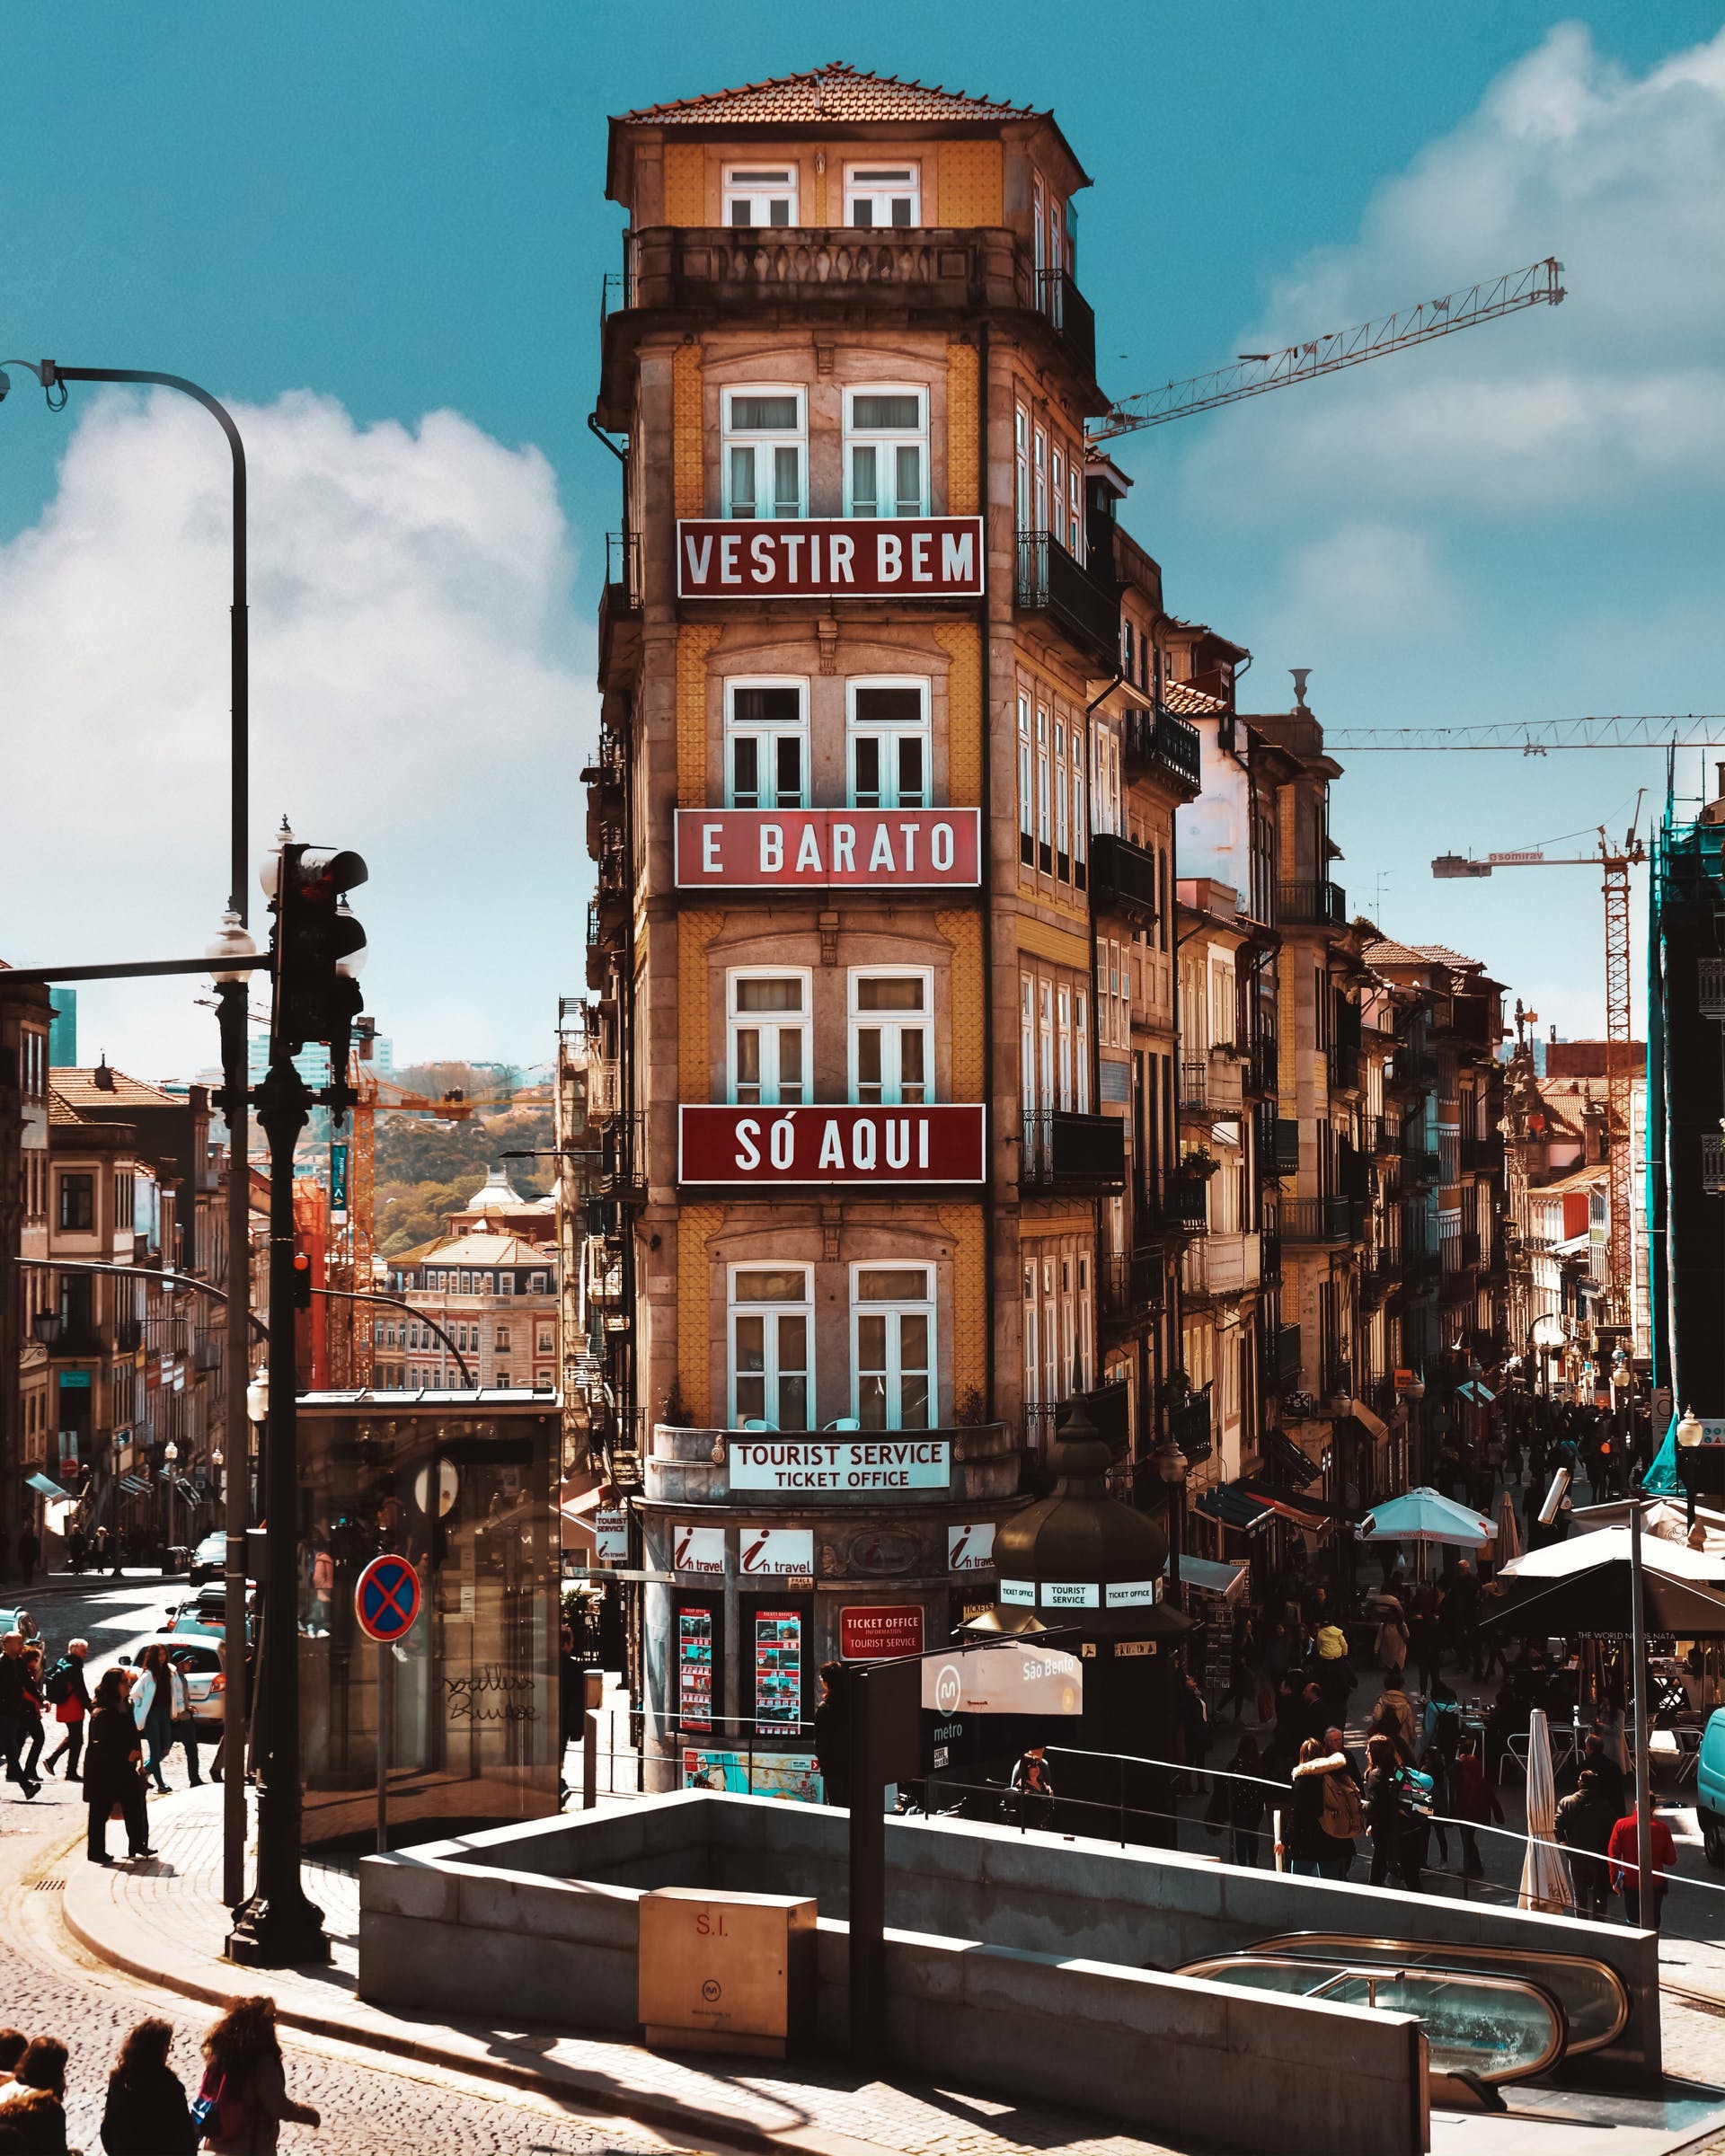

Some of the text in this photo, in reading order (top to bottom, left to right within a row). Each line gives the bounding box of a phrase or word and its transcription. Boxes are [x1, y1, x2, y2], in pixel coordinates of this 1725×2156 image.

[684, 533, 974, 584] VESTIR BEM
[703, 822, 956, 872] E BARATO
[734, 1111, 930, 1171] SÓ AQUI
[738, 1444, 942, 1465] TOURIST SERVICE
[774, 1471, 909, 1487] TICKET OFFICE
[696, 1560, 723, 1572] travel
[775, 1560, 811, 1573] travel
[974, 1556, 996, 1568] trave
[1003, 1587, 1034, 1598] TICKET OFFICE
[1051, 1586, 1086, 1595] TOURIST
[1109, 1589, 1150, 1599] TICKET OFFICE
[1052, 1595, 1085, 1604] SERVICE
[847, 1617, 919, 1629] TICKET OFFICE
[1578, 1631, 1592, 1639] THE
[1593, 1631, 1623, 1639] WORLD
[851, 1638, 916, 1648] TOURIST SERVICE
[1023, 1657, 1075, 1682] São Bento
[934, 1722, 963, 1742] metro
